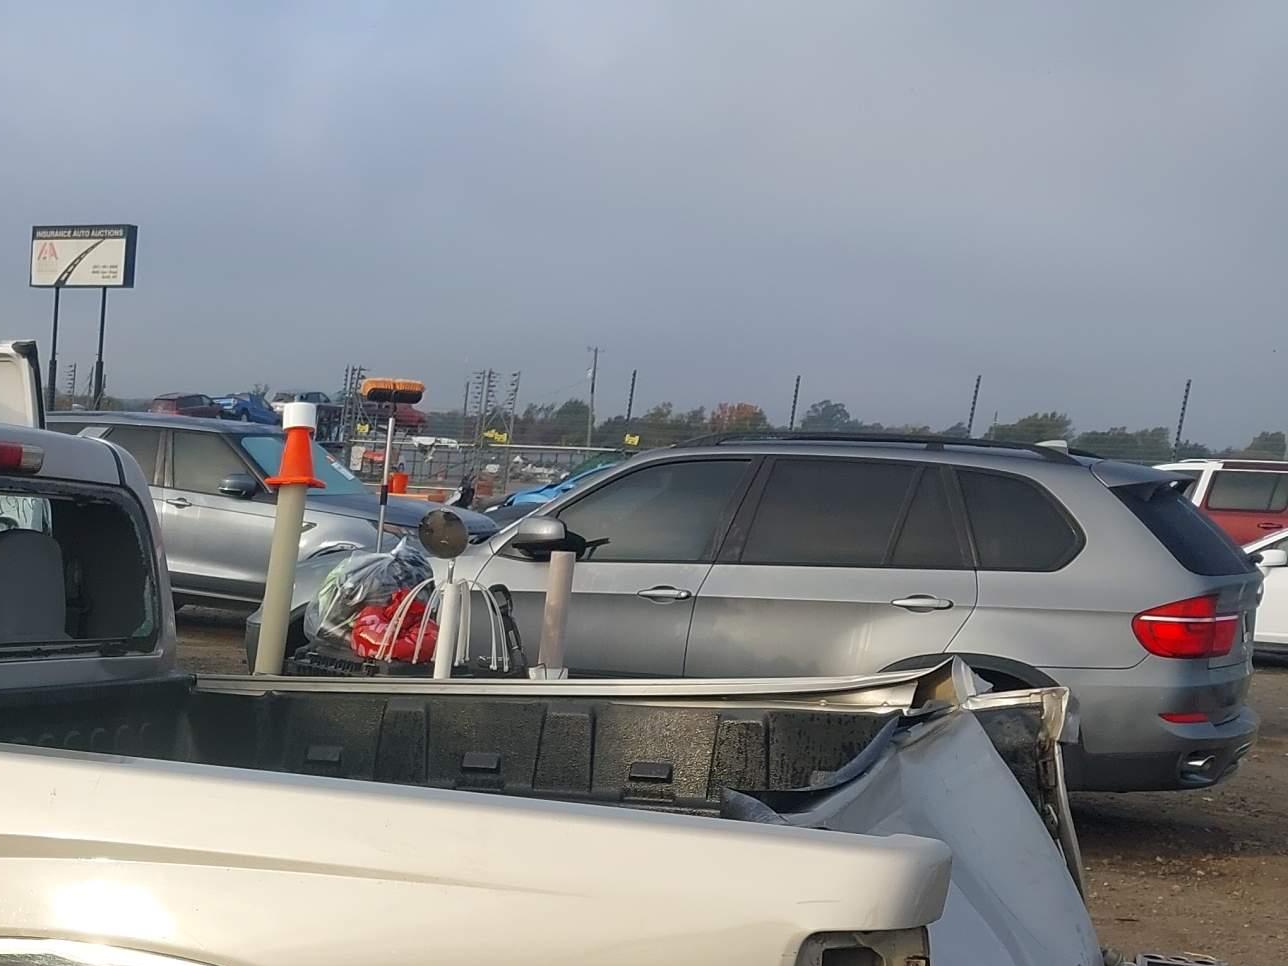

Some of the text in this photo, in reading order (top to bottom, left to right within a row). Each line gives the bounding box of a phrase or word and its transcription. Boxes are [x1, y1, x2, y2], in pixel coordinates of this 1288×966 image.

[36, 228, 123, 238] INSURANCE AUTO AUCTIONS
